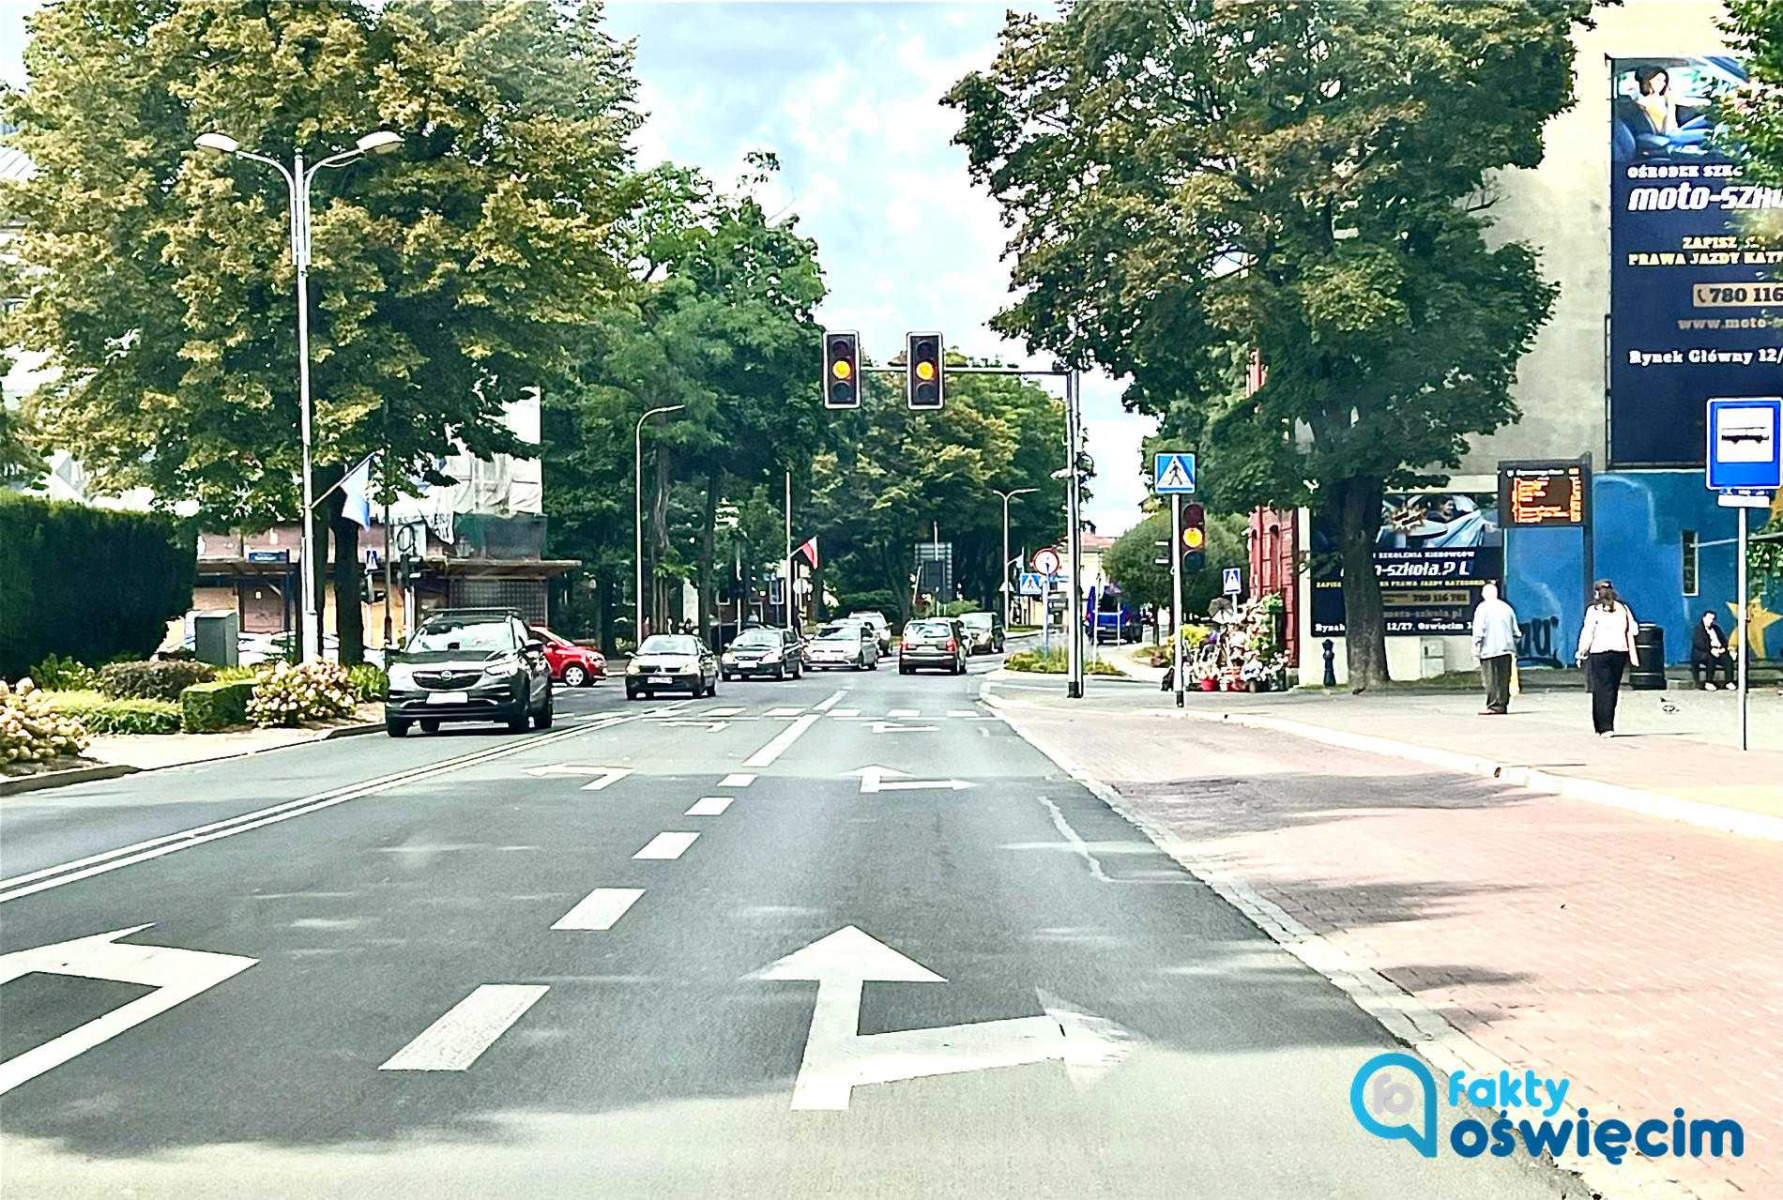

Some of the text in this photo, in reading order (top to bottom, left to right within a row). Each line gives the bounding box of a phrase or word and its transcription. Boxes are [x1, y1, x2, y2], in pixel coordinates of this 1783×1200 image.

[1627, 164, 1700, 178] OŚRODEK
[1682, 236, 1737, 249] ZAPISZ
[1628, 253, 1686, 265] PRAWA
[1689, 252, 1740, 265] JAZDY
[1709, 287, 1783, 303] 780 116
[1629, 349, 1683, 366] Rynek
[1688, 349, 1753, 365] Główny
